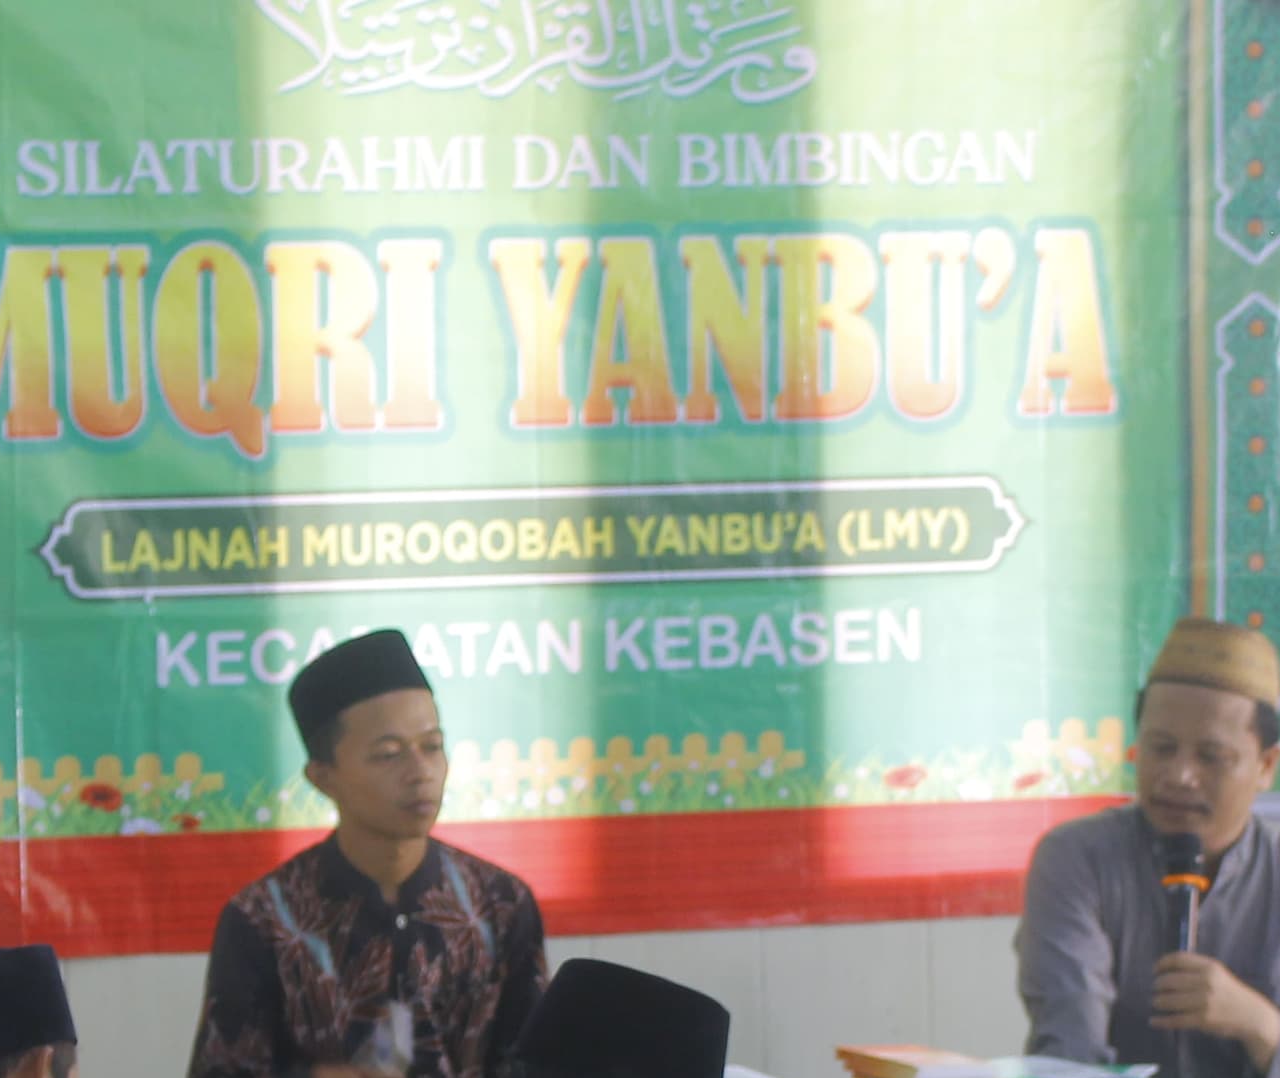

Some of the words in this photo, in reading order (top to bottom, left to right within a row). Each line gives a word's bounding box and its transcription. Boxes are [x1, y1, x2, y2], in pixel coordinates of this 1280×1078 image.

[16, 134, 486, 196] SILATURAHMI
[513, 134, 652, 189] DAN
[677, 130, 1038, 187] BIMBINGAN
[101, 526, 289, 574] LAJNAH
[302, 515, 615, 566] MUROQOBAH
[837, 506, 971, 556] (LMY)
[605, 608, 921, 672] KEBASEN
